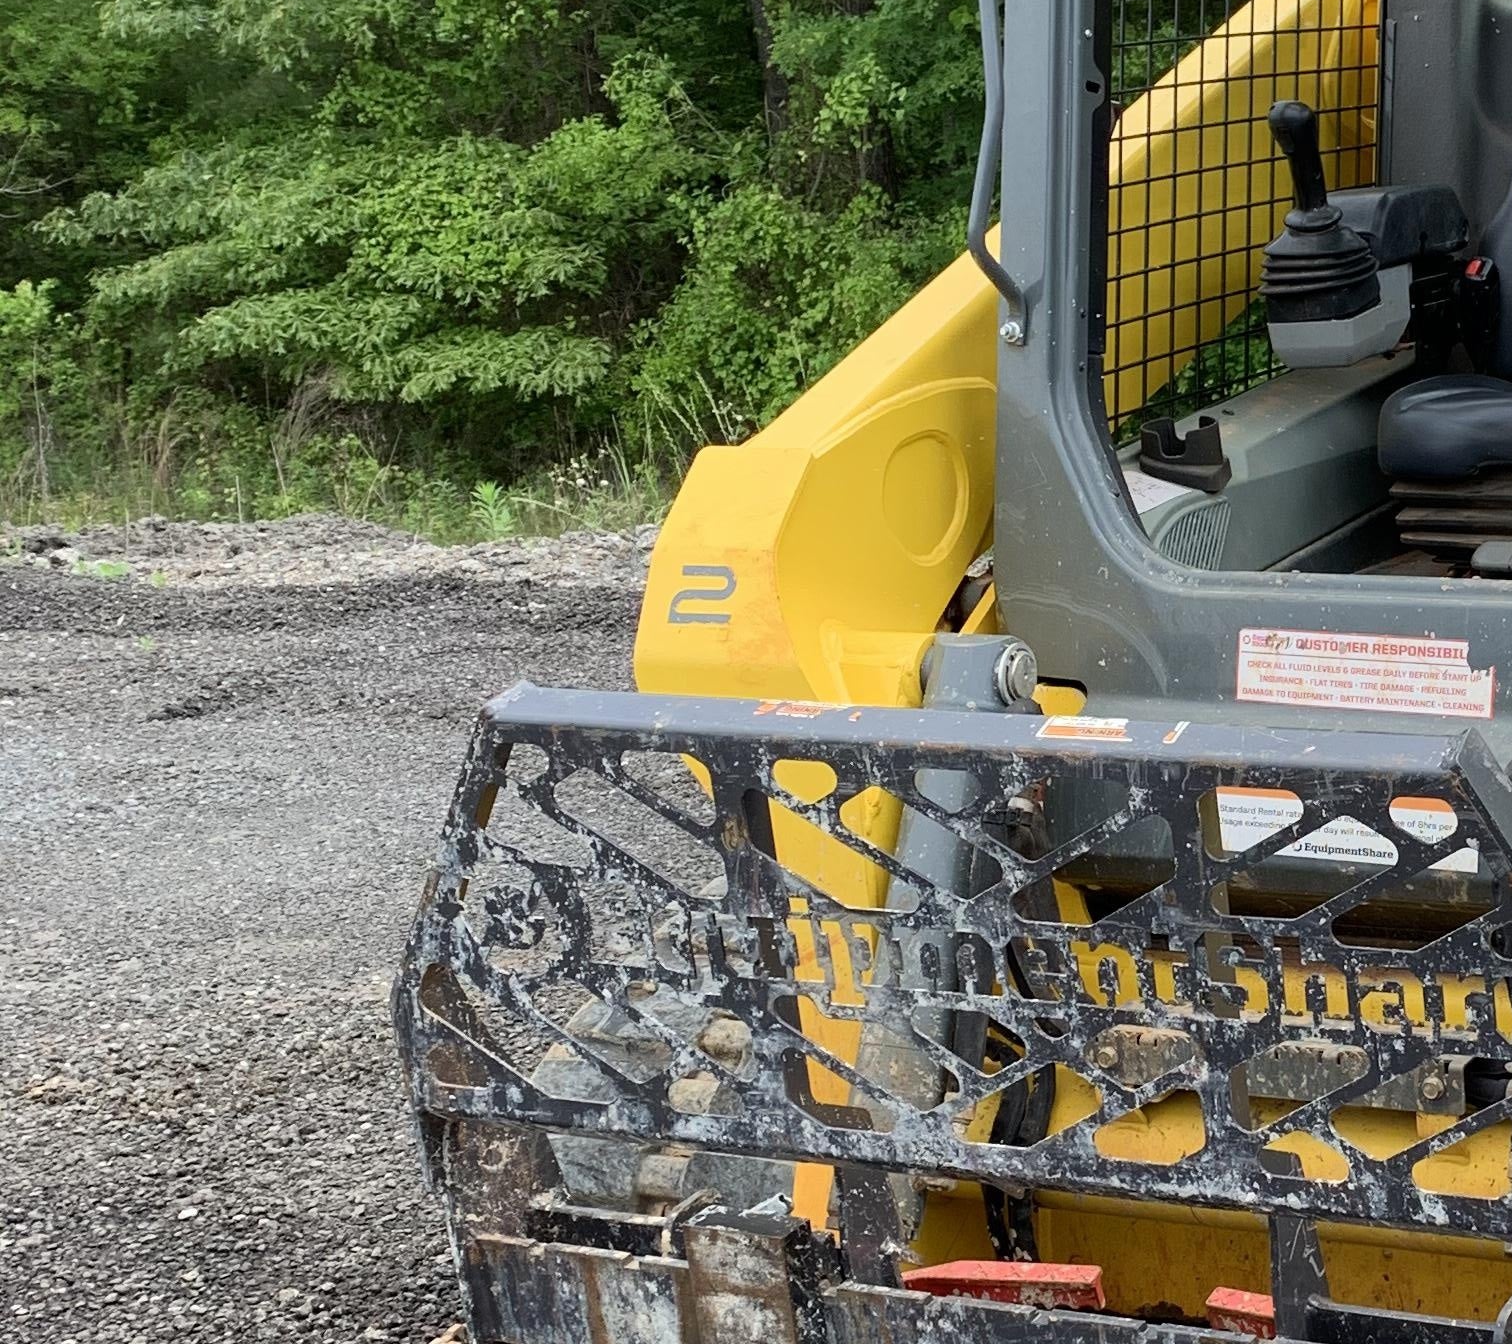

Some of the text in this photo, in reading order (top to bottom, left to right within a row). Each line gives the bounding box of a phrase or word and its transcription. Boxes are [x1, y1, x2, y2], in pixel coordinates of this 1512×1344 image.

[668, 565, 737, 624] 2
[1247, 660, 1272, 669] CHECK
[1273, 661, 1287, 670] ALL
[1288, 662, 1312, 672] FLUID
[1313, 664, 1341, 674] LEVELS
[1350, 666, 1381, 677] GREASE
[1383, 669, 1406, 678] DAILY
[1408, 670, 1440, 680] BEFORE
[1441, 671, 1468, 682] START
[1470, 674, 1482, 683] UP
[1259, 674, 1467, 697] INSURANCE FLAT TIRES TIRE DAMAGE REFUELING
[1242, 687, 1485, 712] DAMAGE TO EQUIPMENT BATTERY MAINTENANCE CLEANING
[1220, 804, 1257, 815] Standard
[1258, 807, 1284, 817] Rental
[1406, 820, 1415, 828] of
[1438, 823, 1453, 831] per
[1323, 826, 1338, 835] day
[1340, 827, 1354, 835] will
[1304, 842, 1394, 859] EquipmentShare
